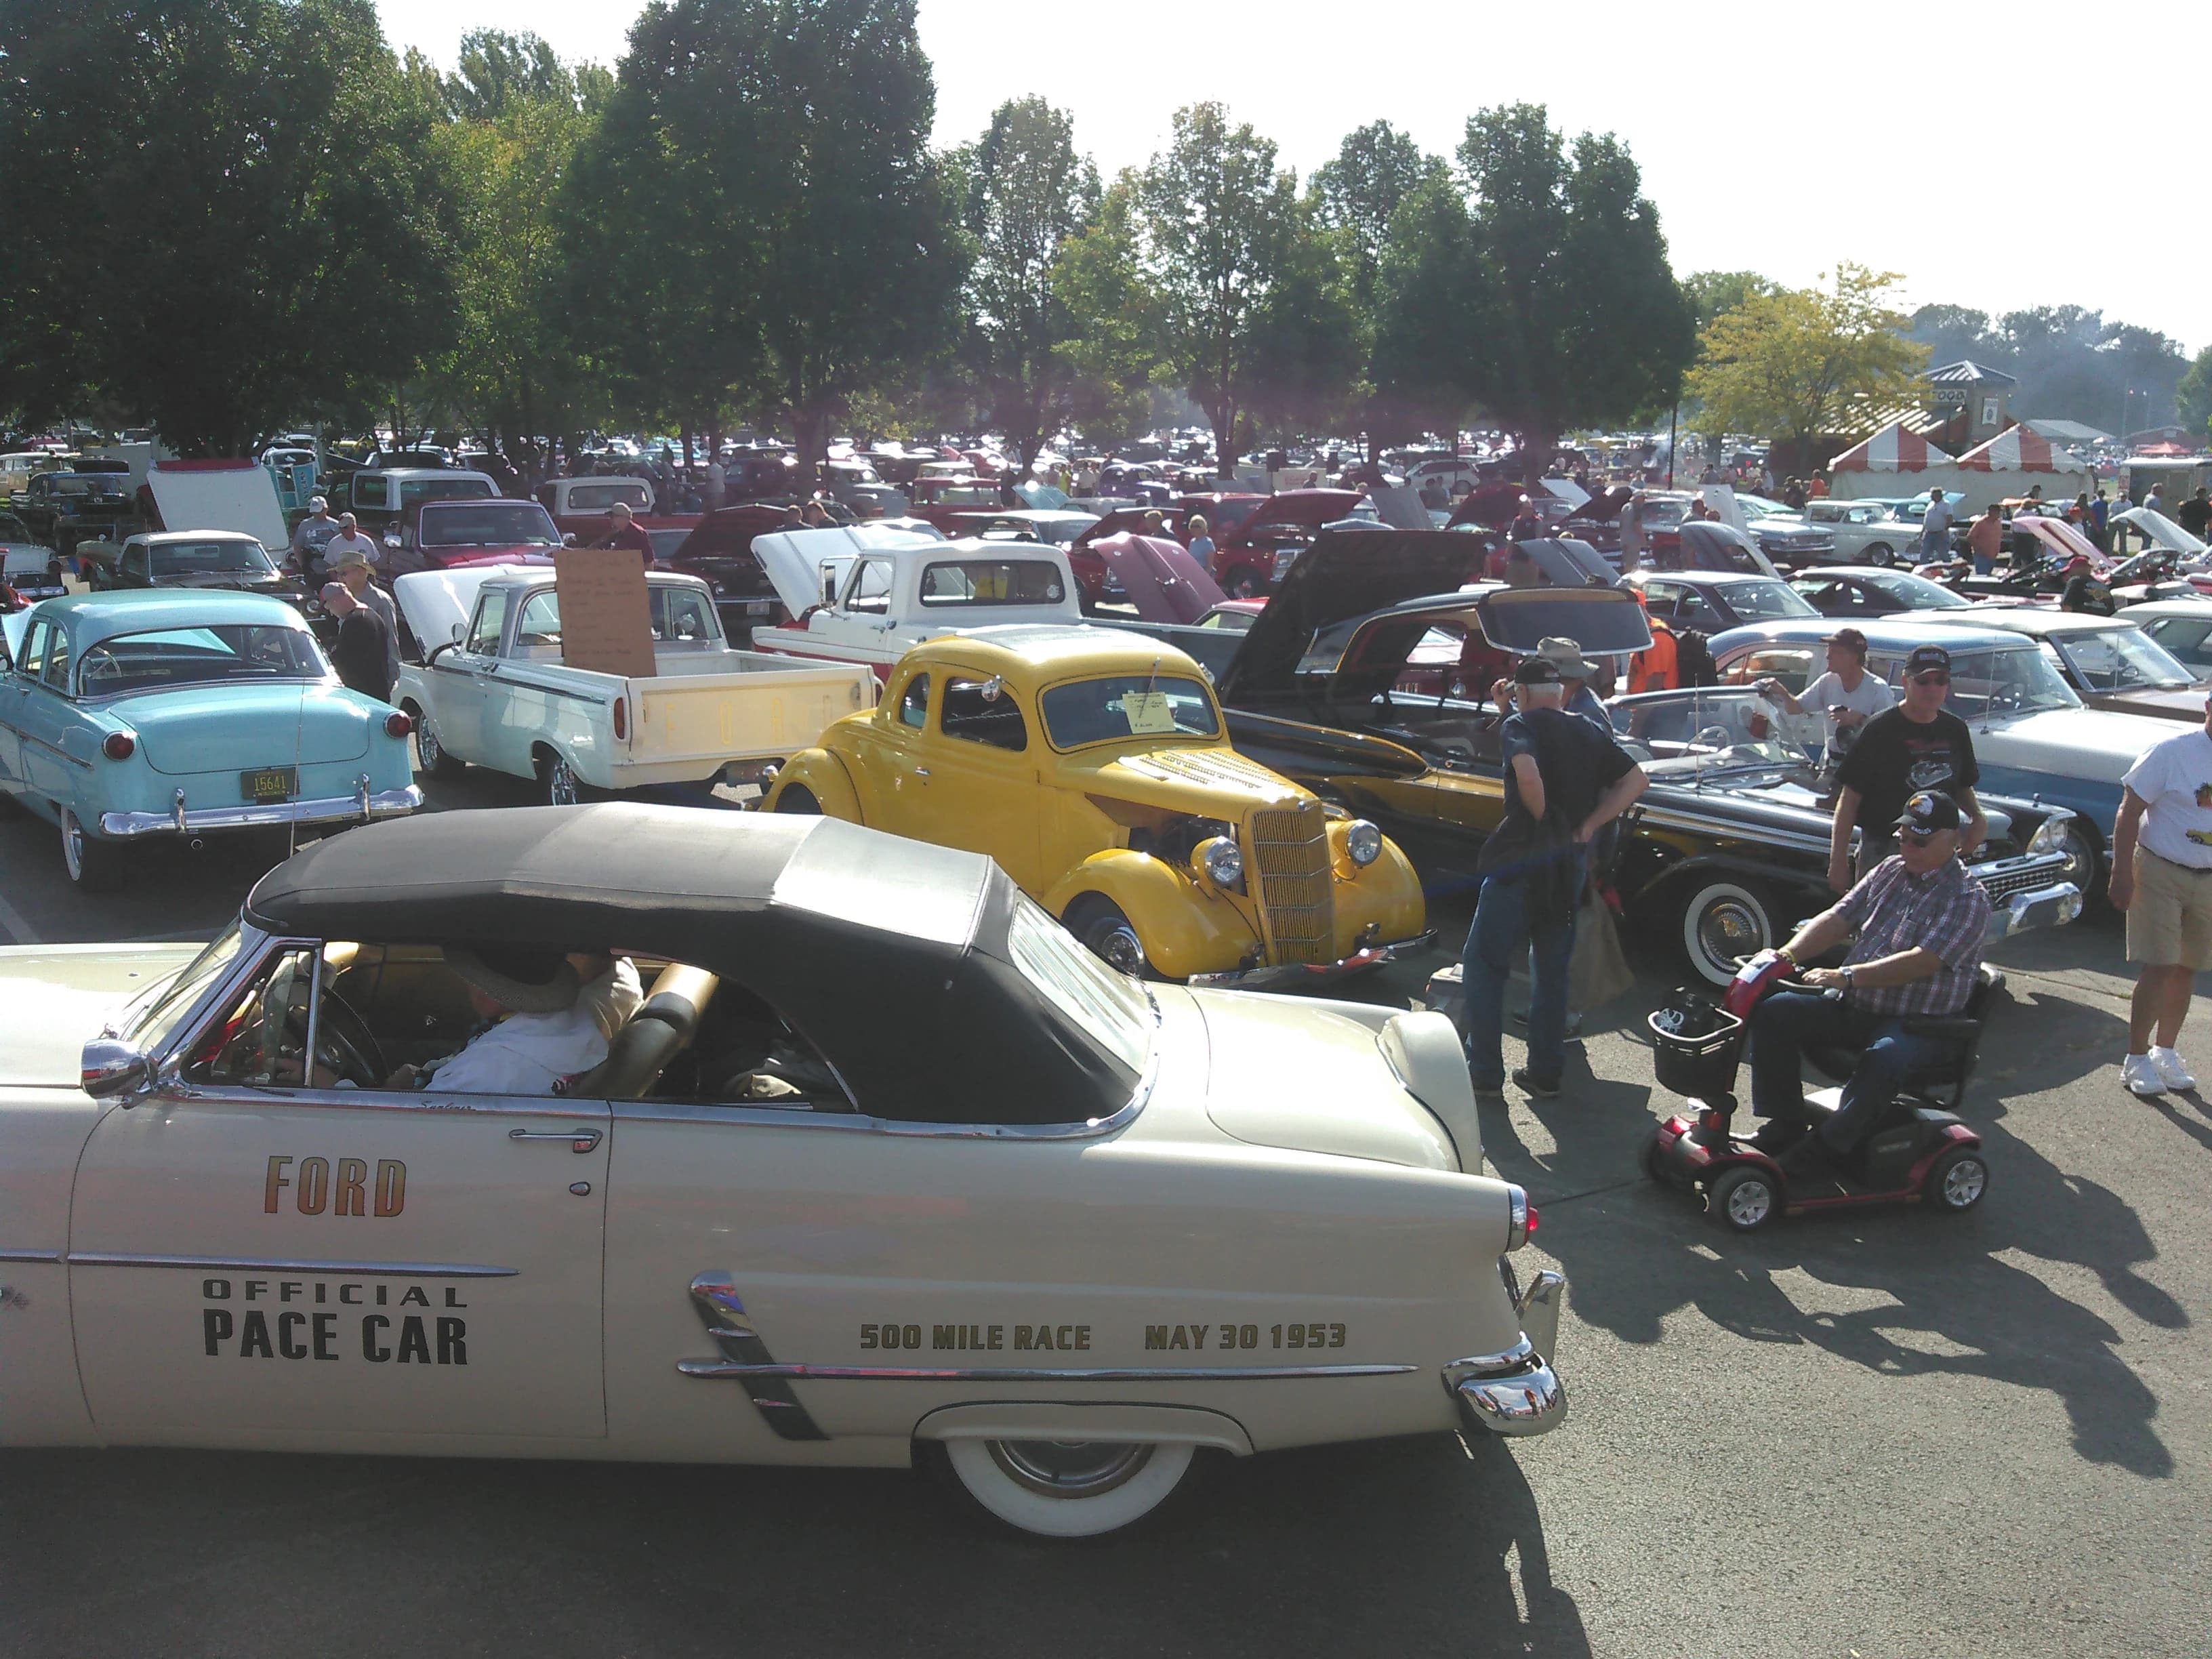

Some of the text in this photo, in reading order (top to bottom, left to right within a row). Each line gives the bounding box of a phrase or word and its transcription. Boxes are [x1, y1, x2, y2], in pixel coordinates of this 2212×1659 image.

[254, 775, 286, 792] 15641
[264, 1155, 407, 1217] FORD
[203, 1279, 468, 1308] OFFICIAL
[203, 1309, 468, 1365] PACE CAR
[860, 1324, 1090, 1351] 500 MILE RACE
[1145, 1323, 1347, 1350] MAY 30 1953
